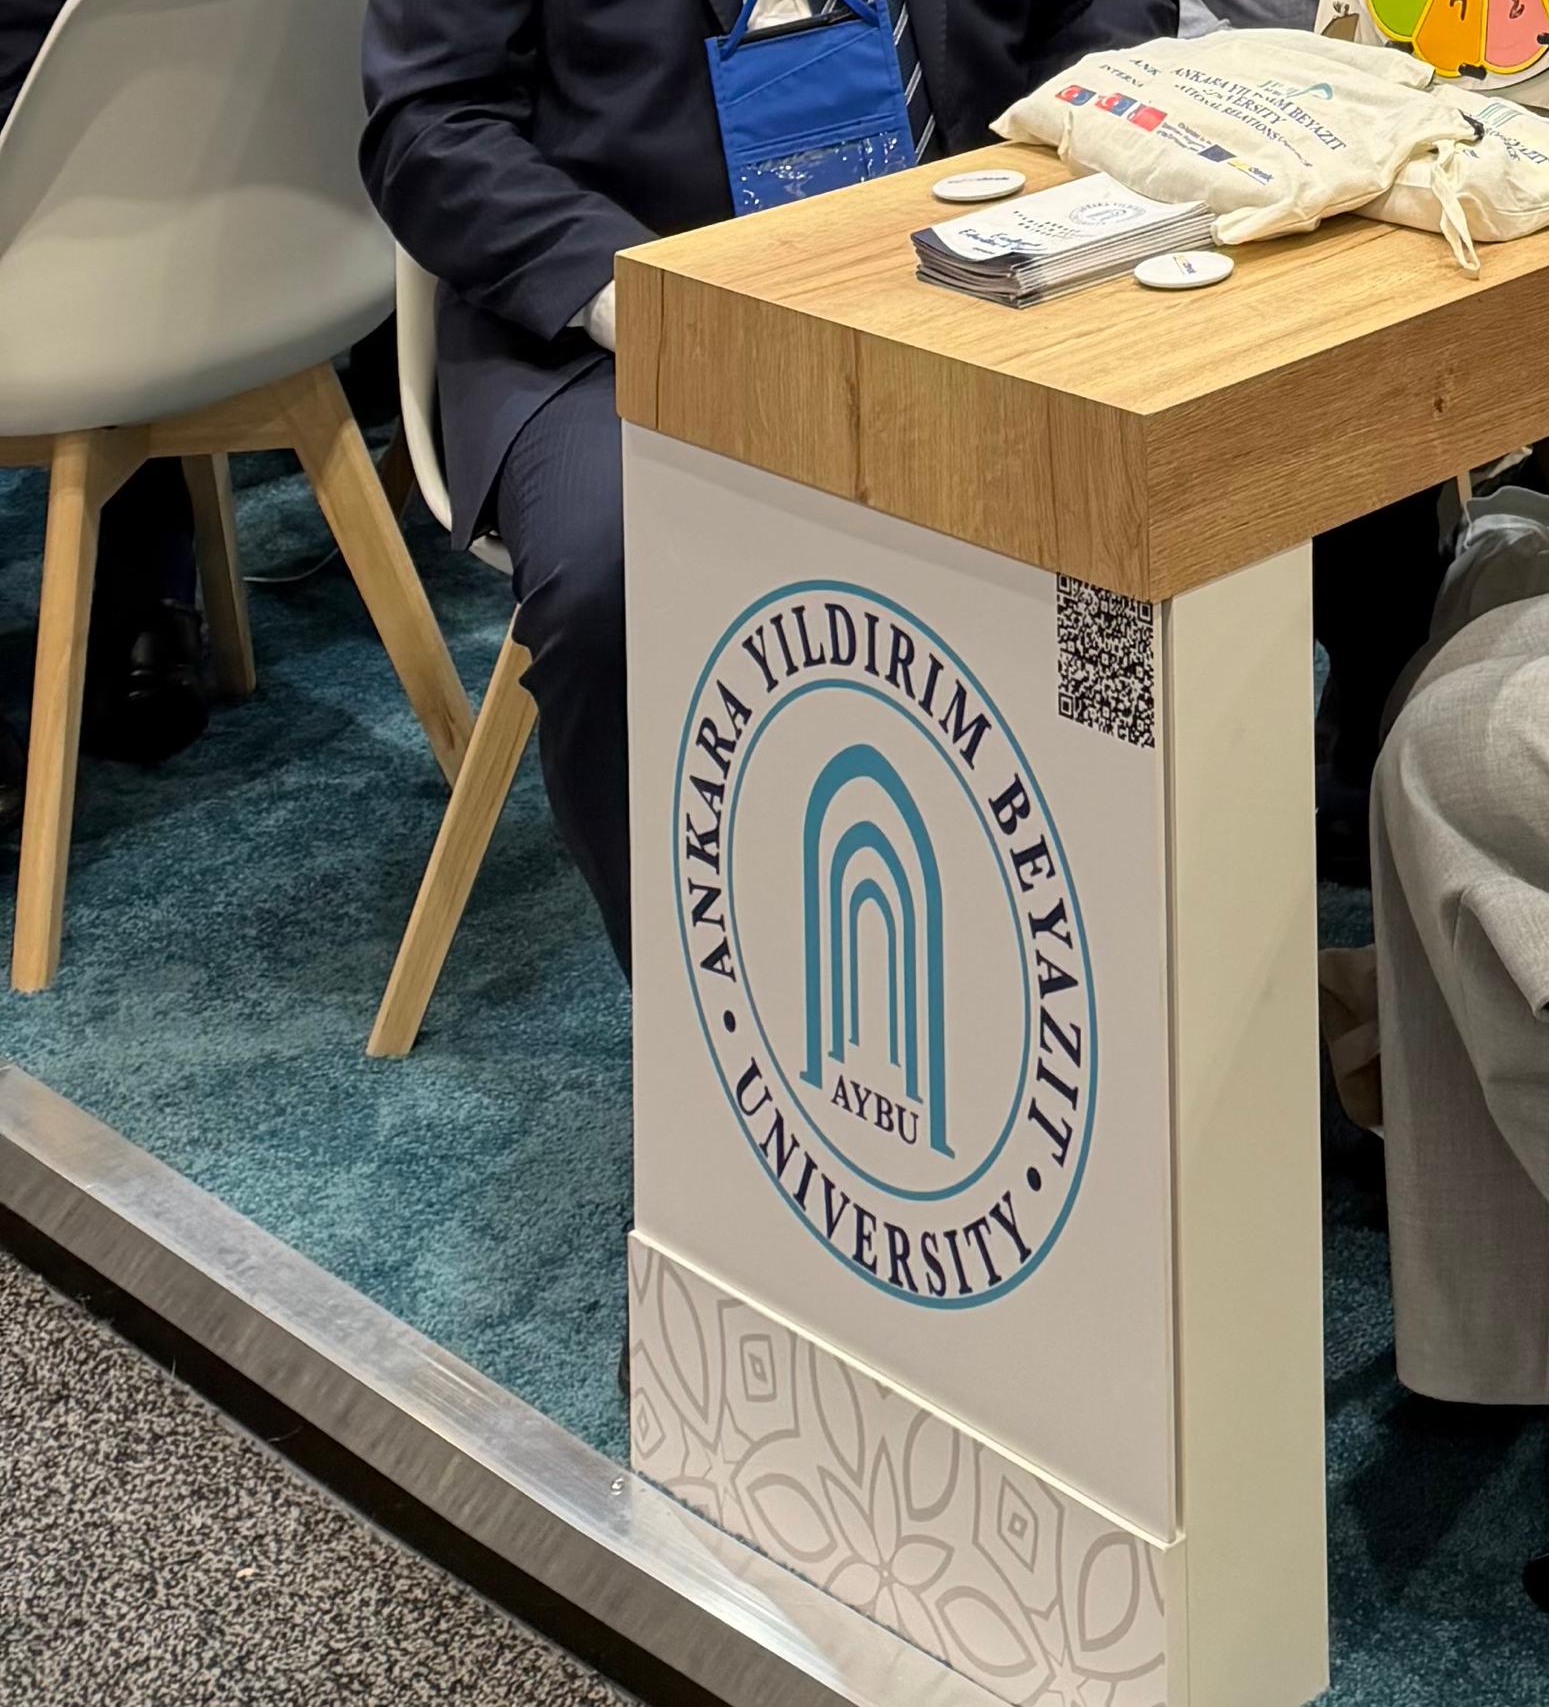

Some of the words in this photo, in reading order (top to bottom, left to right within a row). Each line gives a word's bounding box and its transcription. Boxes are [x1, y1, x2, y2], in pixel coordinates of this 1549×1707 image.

[1289, 103, 1347, 152] BEYAZIT
[686, 678, 754, 984] ANKARA
[742, 602, 993, 771] YILDIRIM
[987, 773, 1083, 1168] BEYAZIT
[735, 1056, 1032, 1298] UNIVERSITY
[831, 1074, 920, 1145] AYBU
